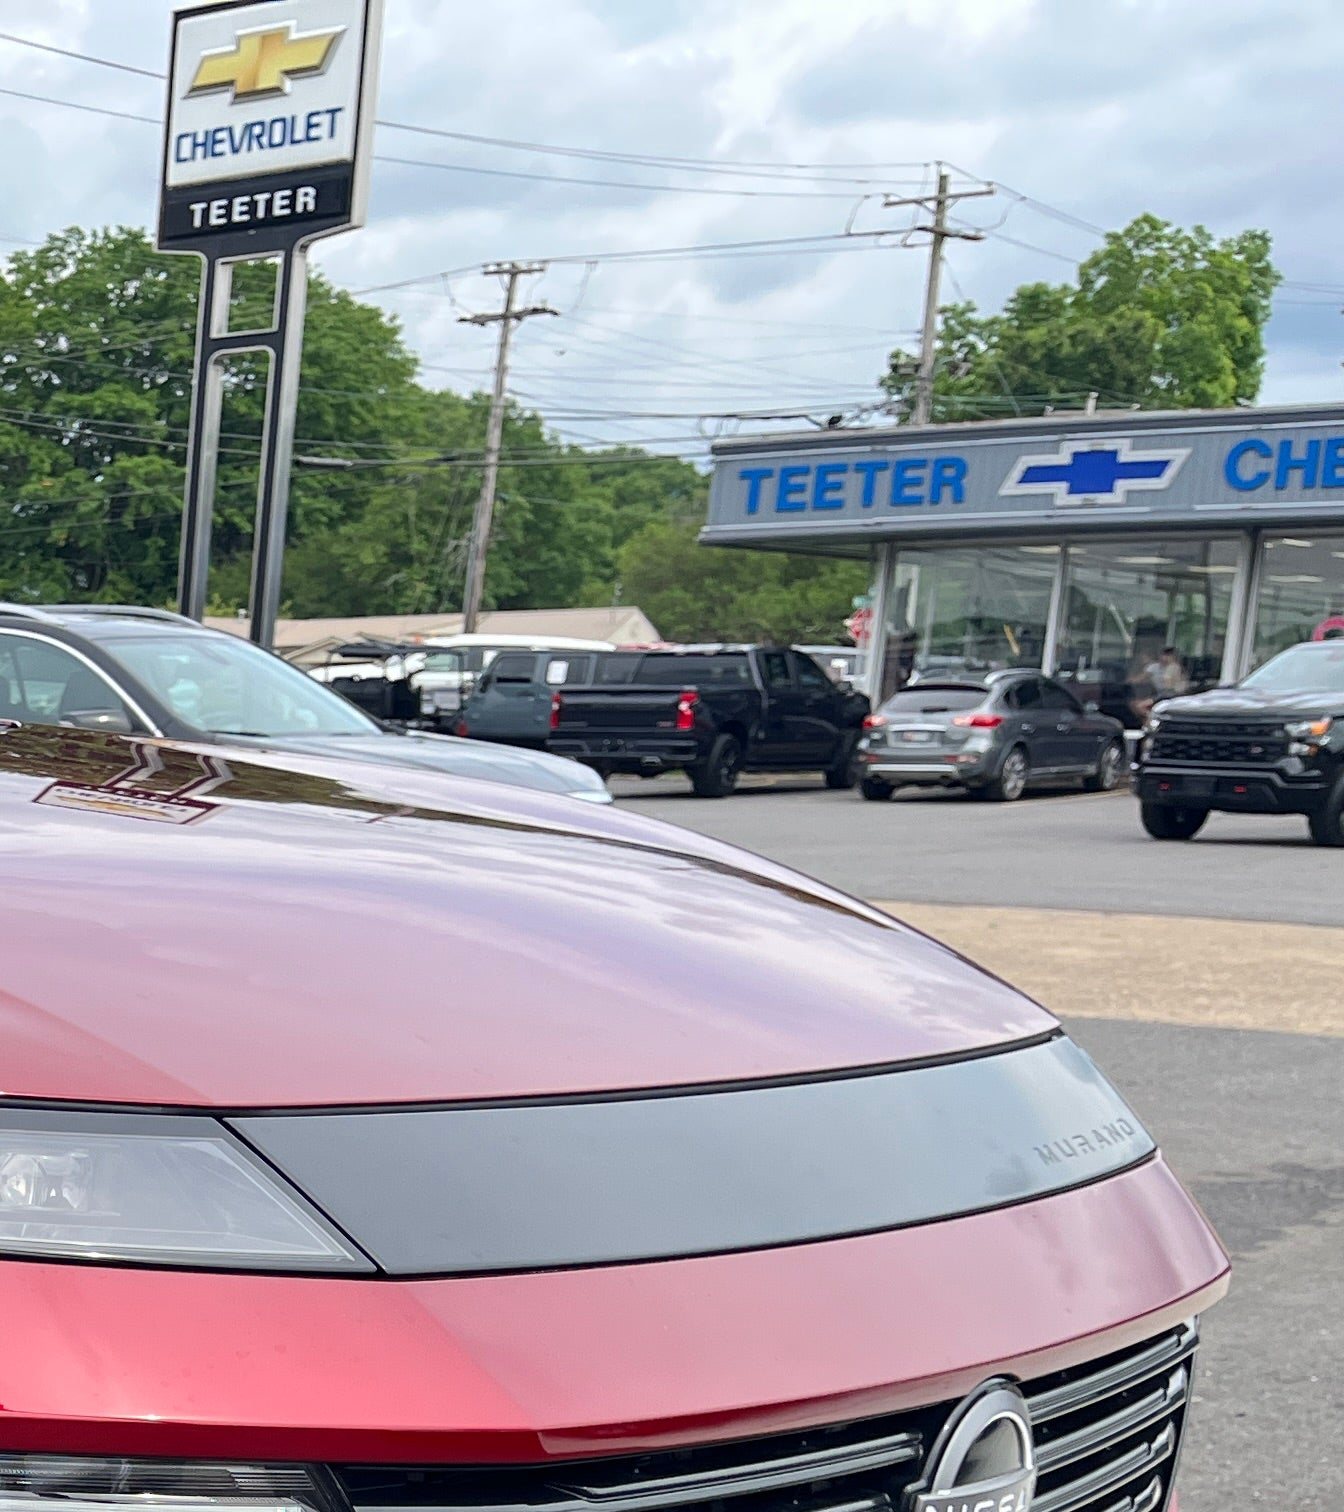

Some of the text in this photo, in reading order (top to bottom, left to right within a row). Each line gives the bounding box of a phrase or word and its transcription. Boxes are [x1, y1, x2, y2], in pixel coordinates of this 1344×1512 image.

[175, 107, 344, 163] CHEVROLET
[190, 186, 317, 228] TEETER
[739, 438, 1344, 514] TEETER CHE
[1032, 1117, 1136, 1166] MURANO
